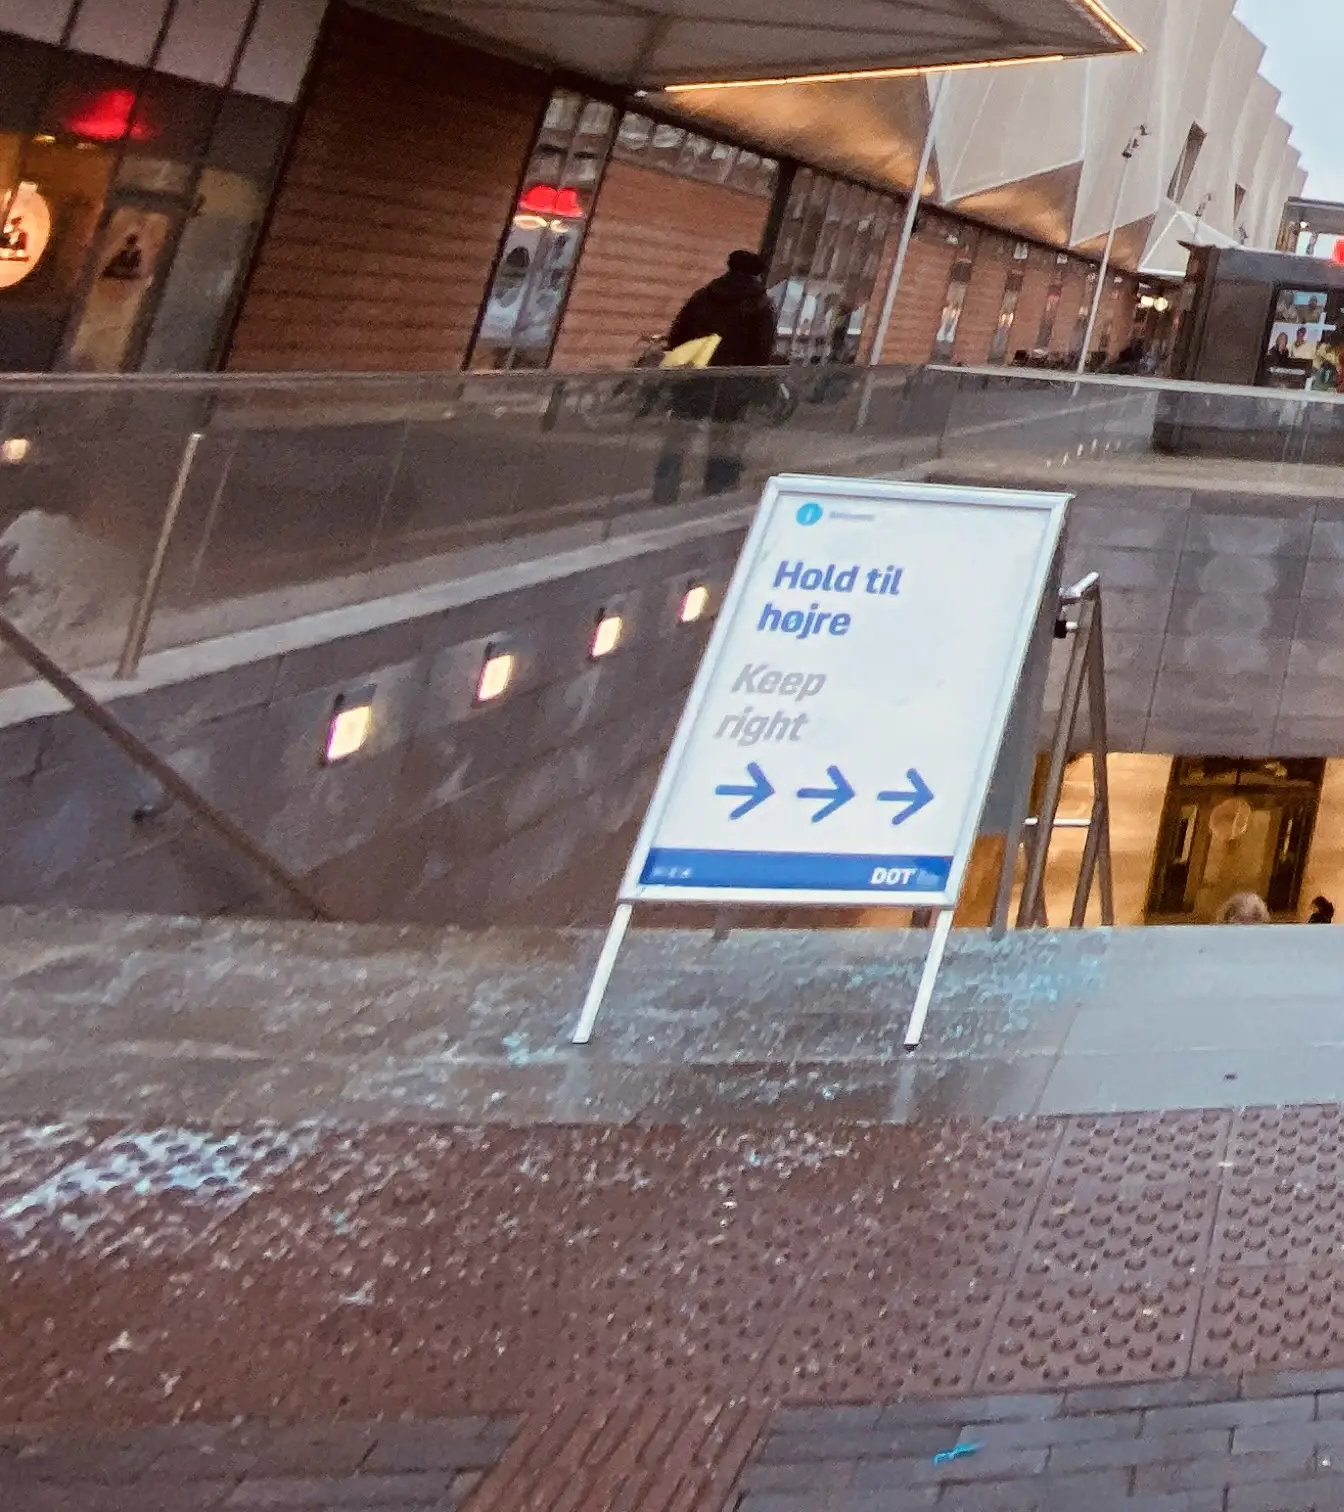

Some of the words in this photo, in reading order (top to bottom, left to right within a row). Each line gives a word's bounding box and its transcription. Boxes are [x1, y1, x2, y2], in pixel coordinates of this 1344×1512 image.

[773, 560, 860, 593] Hold
[866, 565, 904, 595] til
[757, 602, 852, 639] højre
[730, 663, 828, 702] Keep
[713, 705, 810, 747] right
[870, 866, 915, 885] DOT
